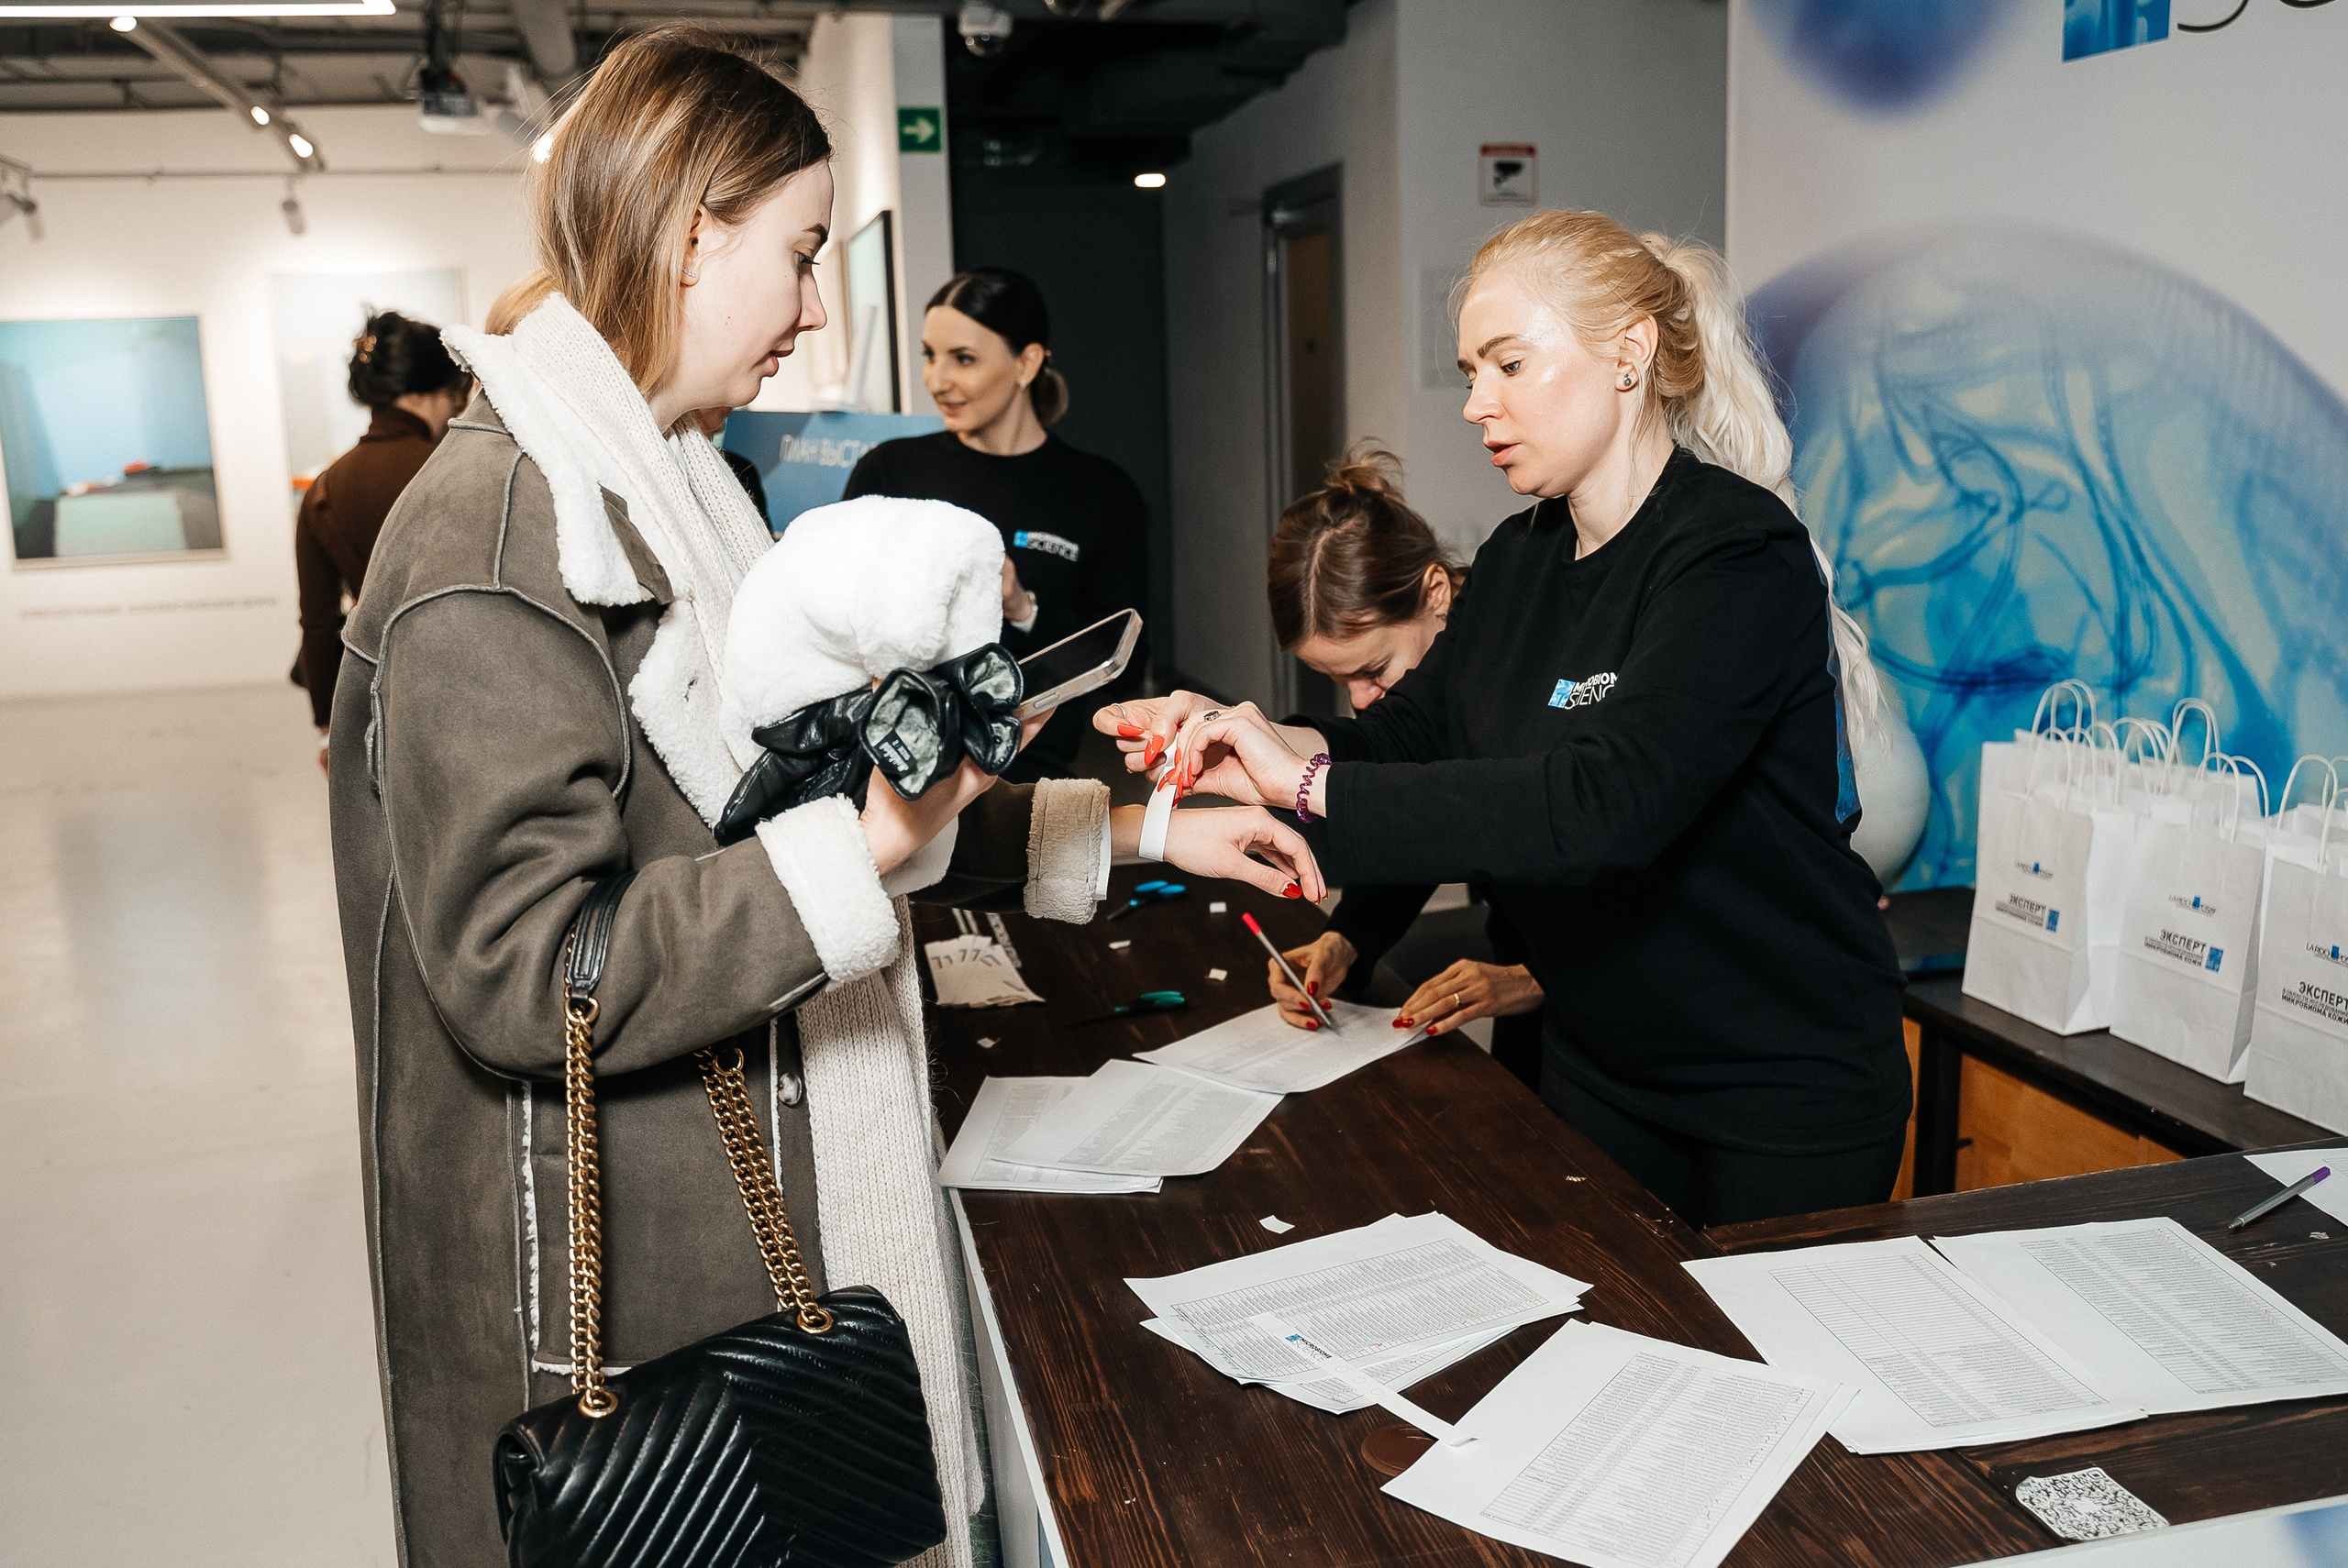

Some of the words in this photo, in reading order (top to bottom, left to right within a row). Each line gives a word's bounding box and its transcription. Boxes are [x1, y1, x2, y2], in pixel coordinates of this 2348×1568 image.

[2009, 893, 2046, 918] ЭКСПЕРТ
[2160, 928, 2207, 955] ЭКСПЕРТ
[2298, 981, 2348, 1010] ЭКСПЕРТ
[2281, 994, 2326, 1018] МИКРОБИОМА
[2327, 1010, 2348, 1026] КОЖИ
